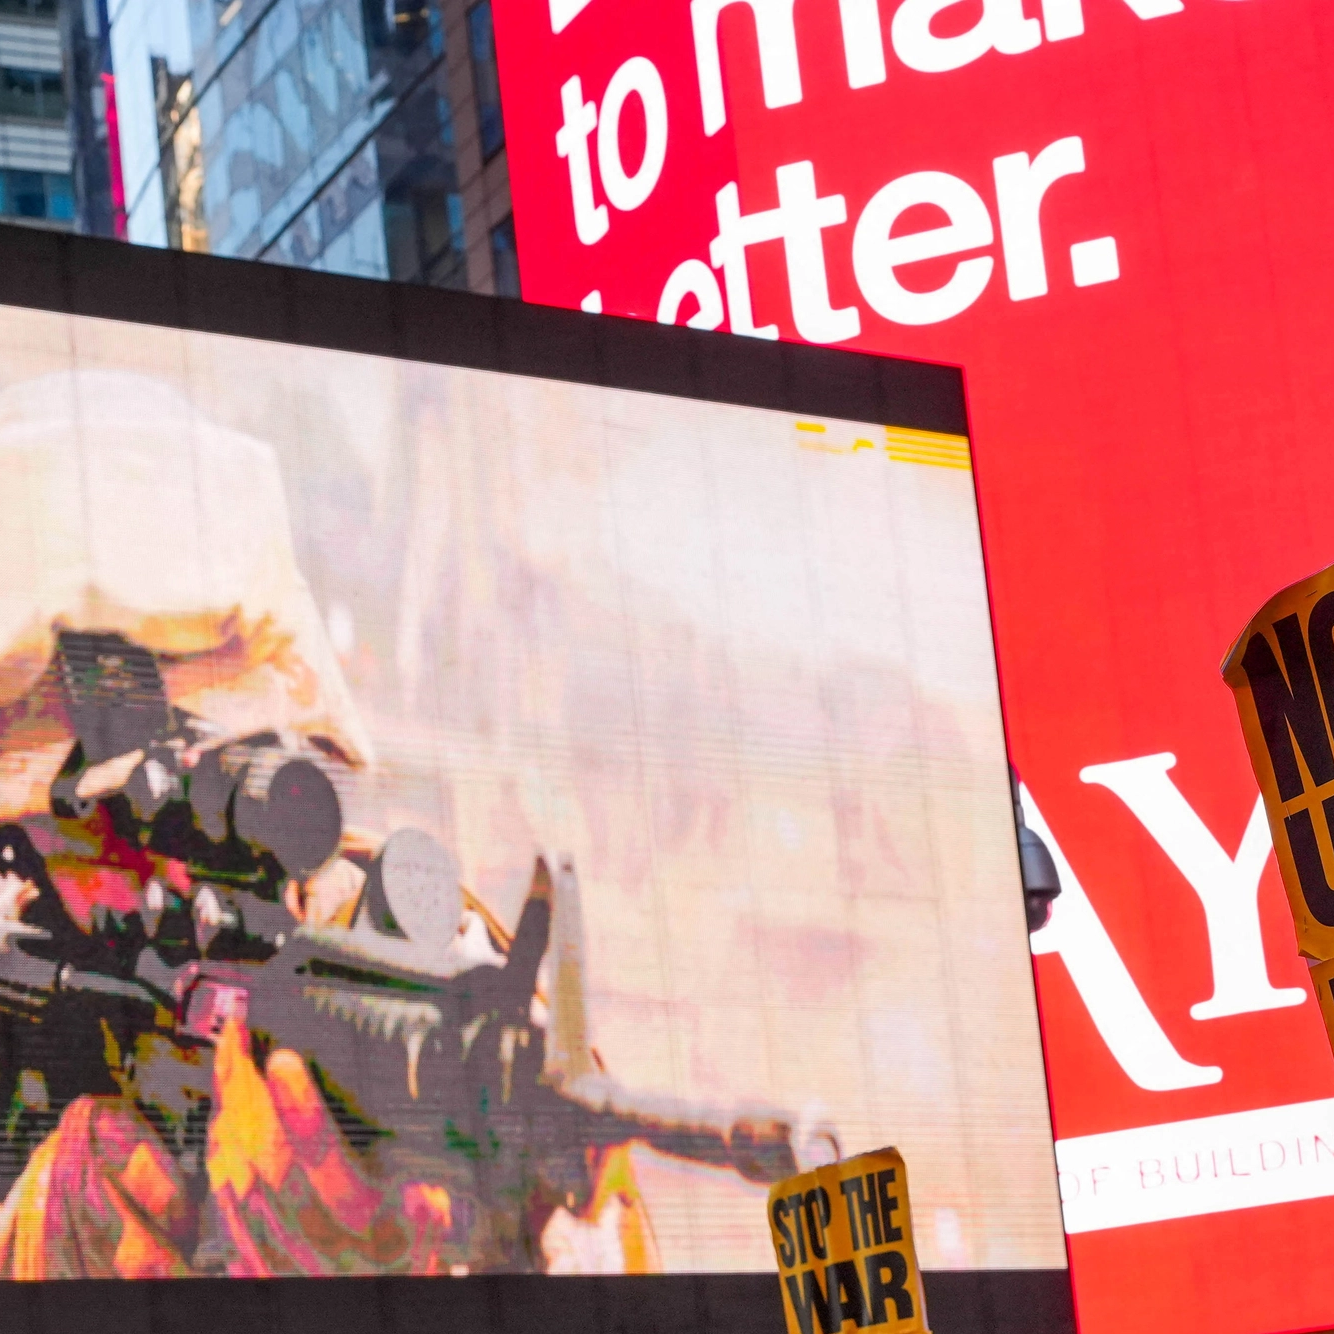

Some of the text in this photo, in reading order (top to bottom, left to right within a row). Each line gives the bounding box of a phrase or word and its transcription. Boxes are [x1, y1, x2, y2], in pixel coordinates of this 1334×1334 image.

[555, 56, 668, 245] to
[772, 1168, 903, 1269] STOP THE
